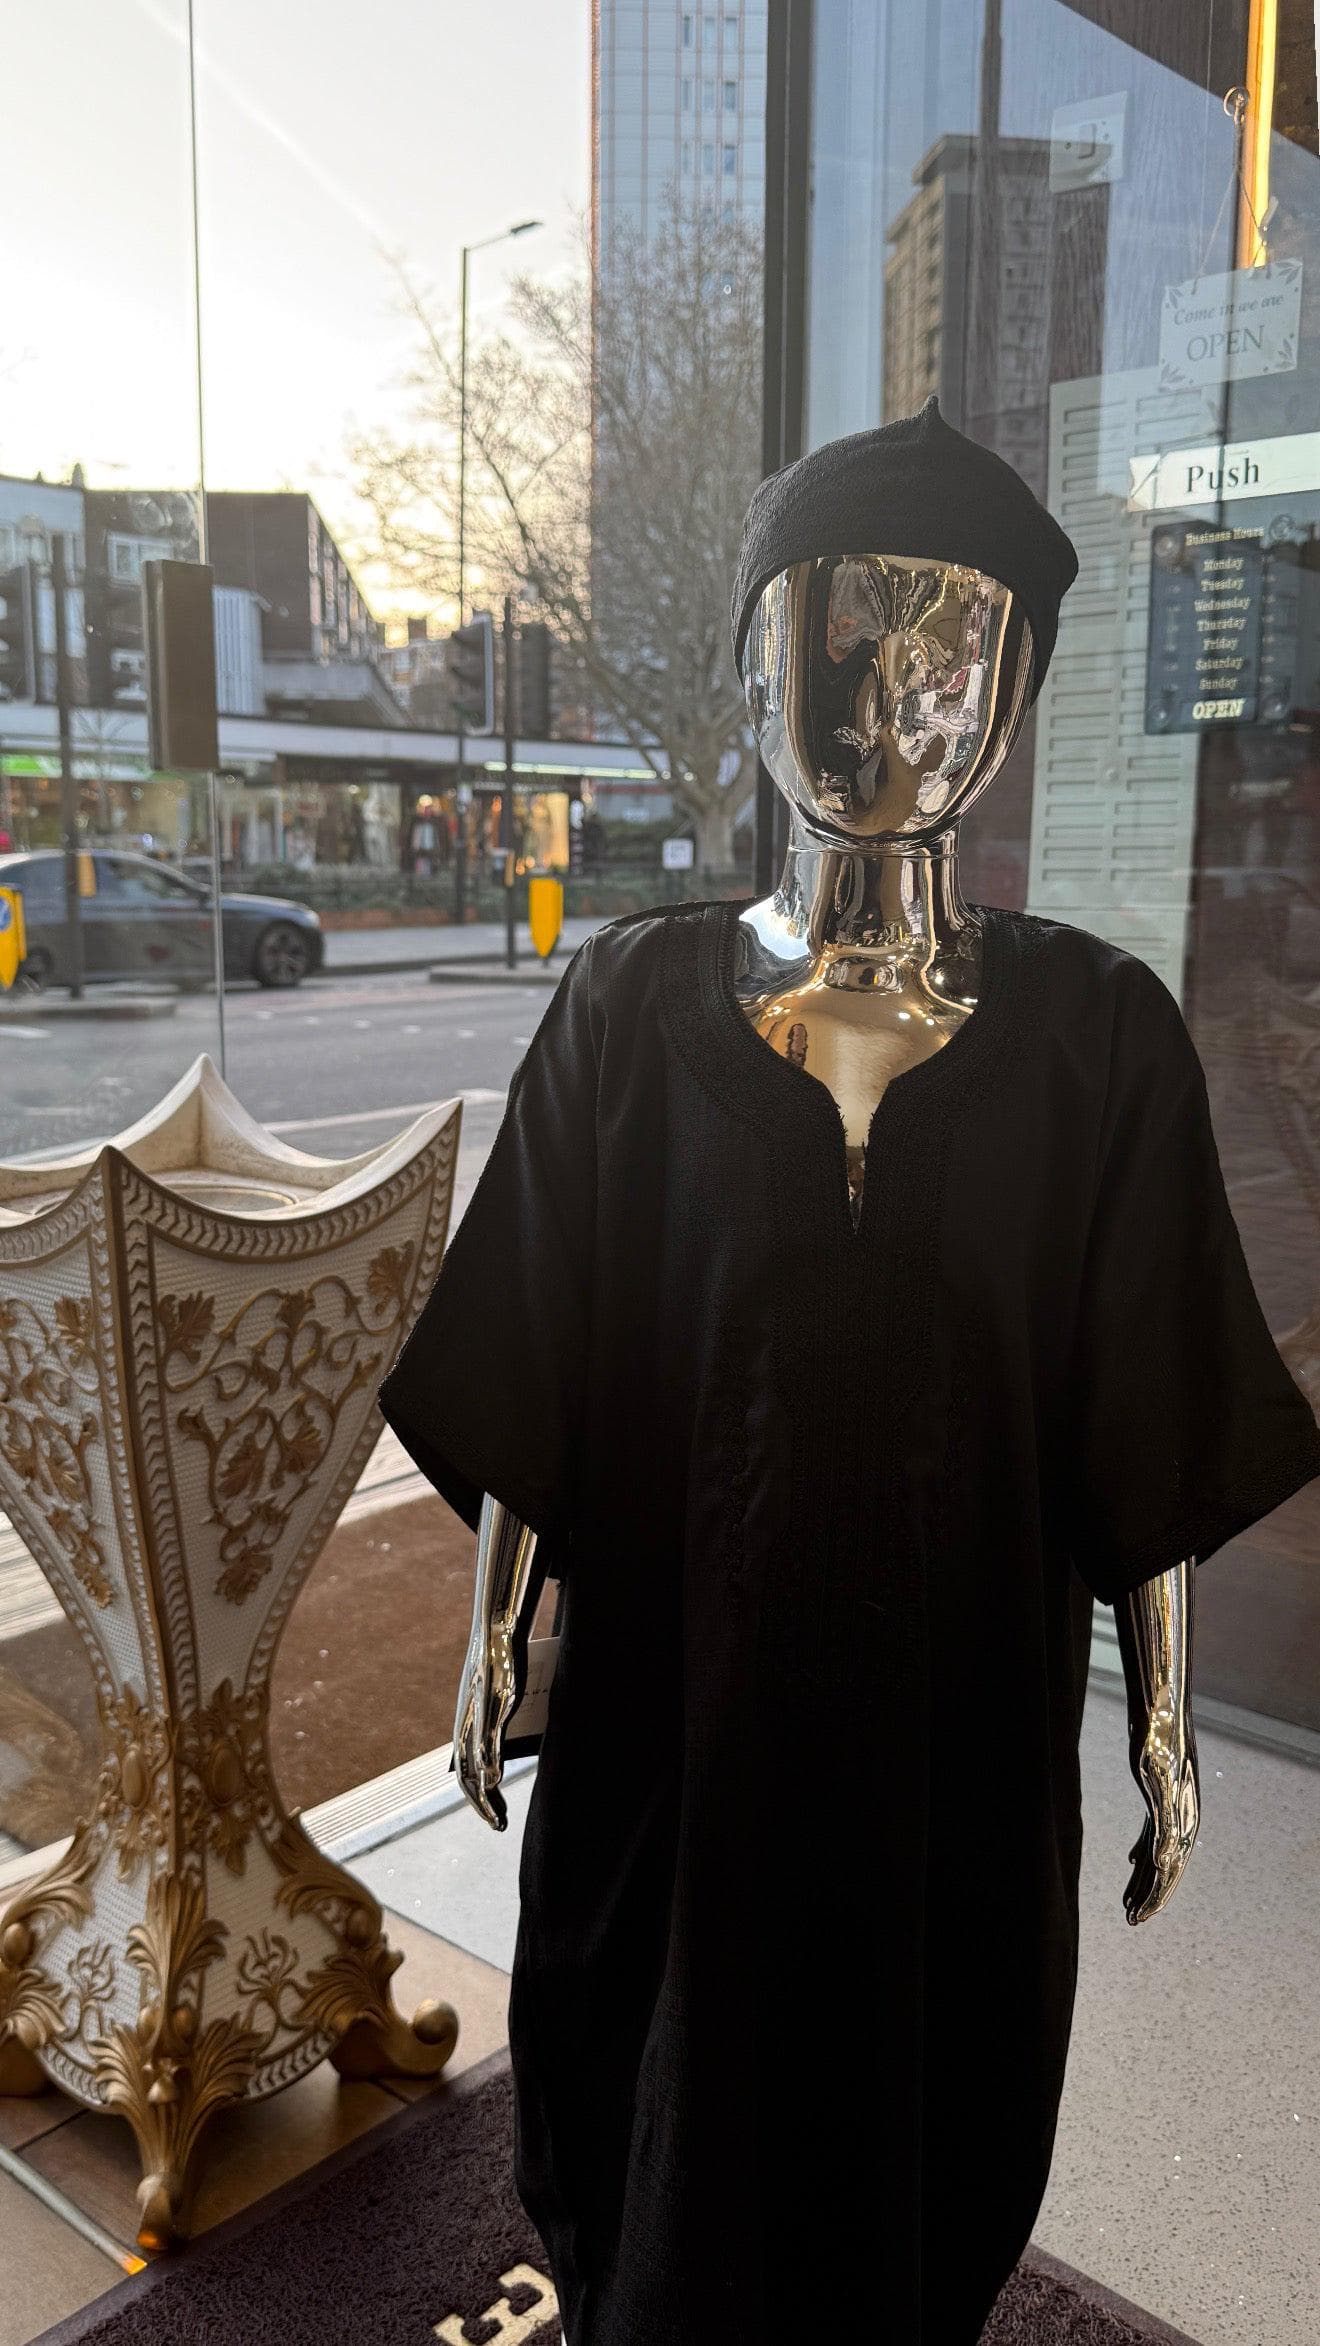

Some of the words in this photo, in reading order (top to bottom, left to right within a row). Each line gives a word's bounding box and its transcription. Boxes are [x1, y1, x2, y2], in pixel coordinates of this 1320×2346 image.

[1174, 308, 1214, 325] Come
[1221, 304, 1234, 316] in
[1239, 300, 1257, 312] we
[1261, 295, 1284, 308] are
[1188, 325, 1265, 361] OPEN
[1188, 457, 1259, 492] Push
[1185, 531, 1232, 545] Business
[1233, 526, 1264, 540] Hours
[1203, 557, 1243, 572] Monday
[1201, 577, 1243, 592] Tuesday
[1194, 597, 1251, 611] Wednesday
[1197, 617, 1246, 631] Thursday
[1203, 637, 1239, 651] Friday
[1196, 655, 1244, 670] Saturday
[1199, 676, 1238, 691] Sunday
[1192, 698, 1246, 720] OPEN
